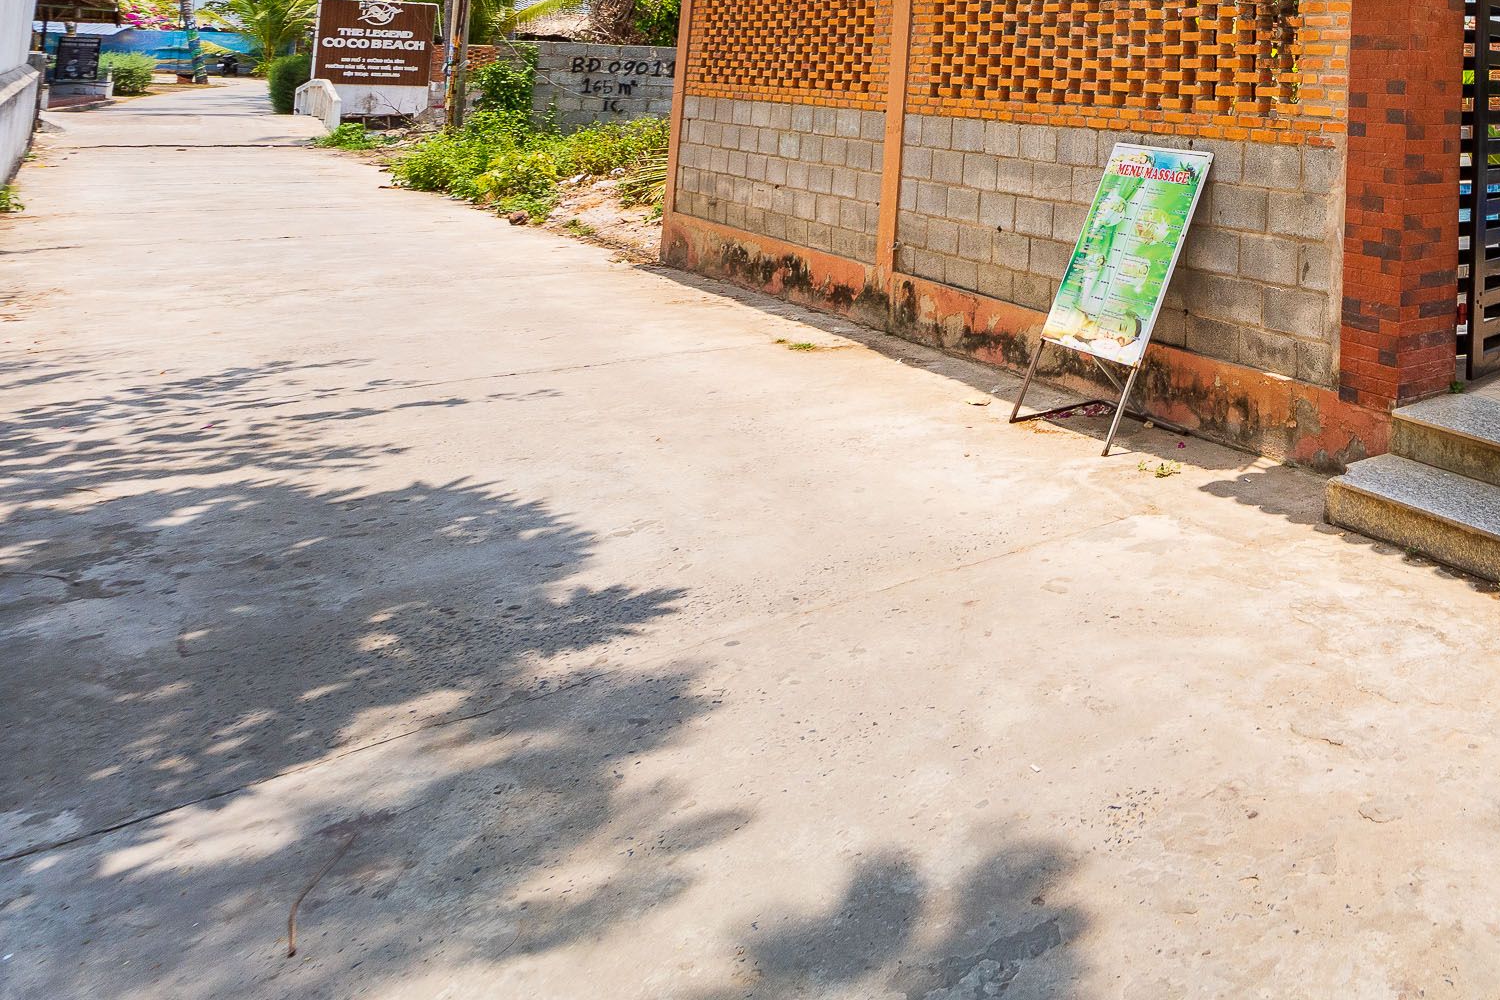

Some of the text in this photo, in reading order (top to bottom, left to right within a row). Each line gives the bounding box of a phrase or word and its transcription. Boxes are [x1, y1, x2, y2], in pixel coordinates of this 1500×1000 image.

[338, 28, 414, 38] THE LEGEND
[371, 40, 425, 51] BEACH
[581, 78, 613, 94] 165
[1118, 163, 1190, 184] MENU MASSAGE
